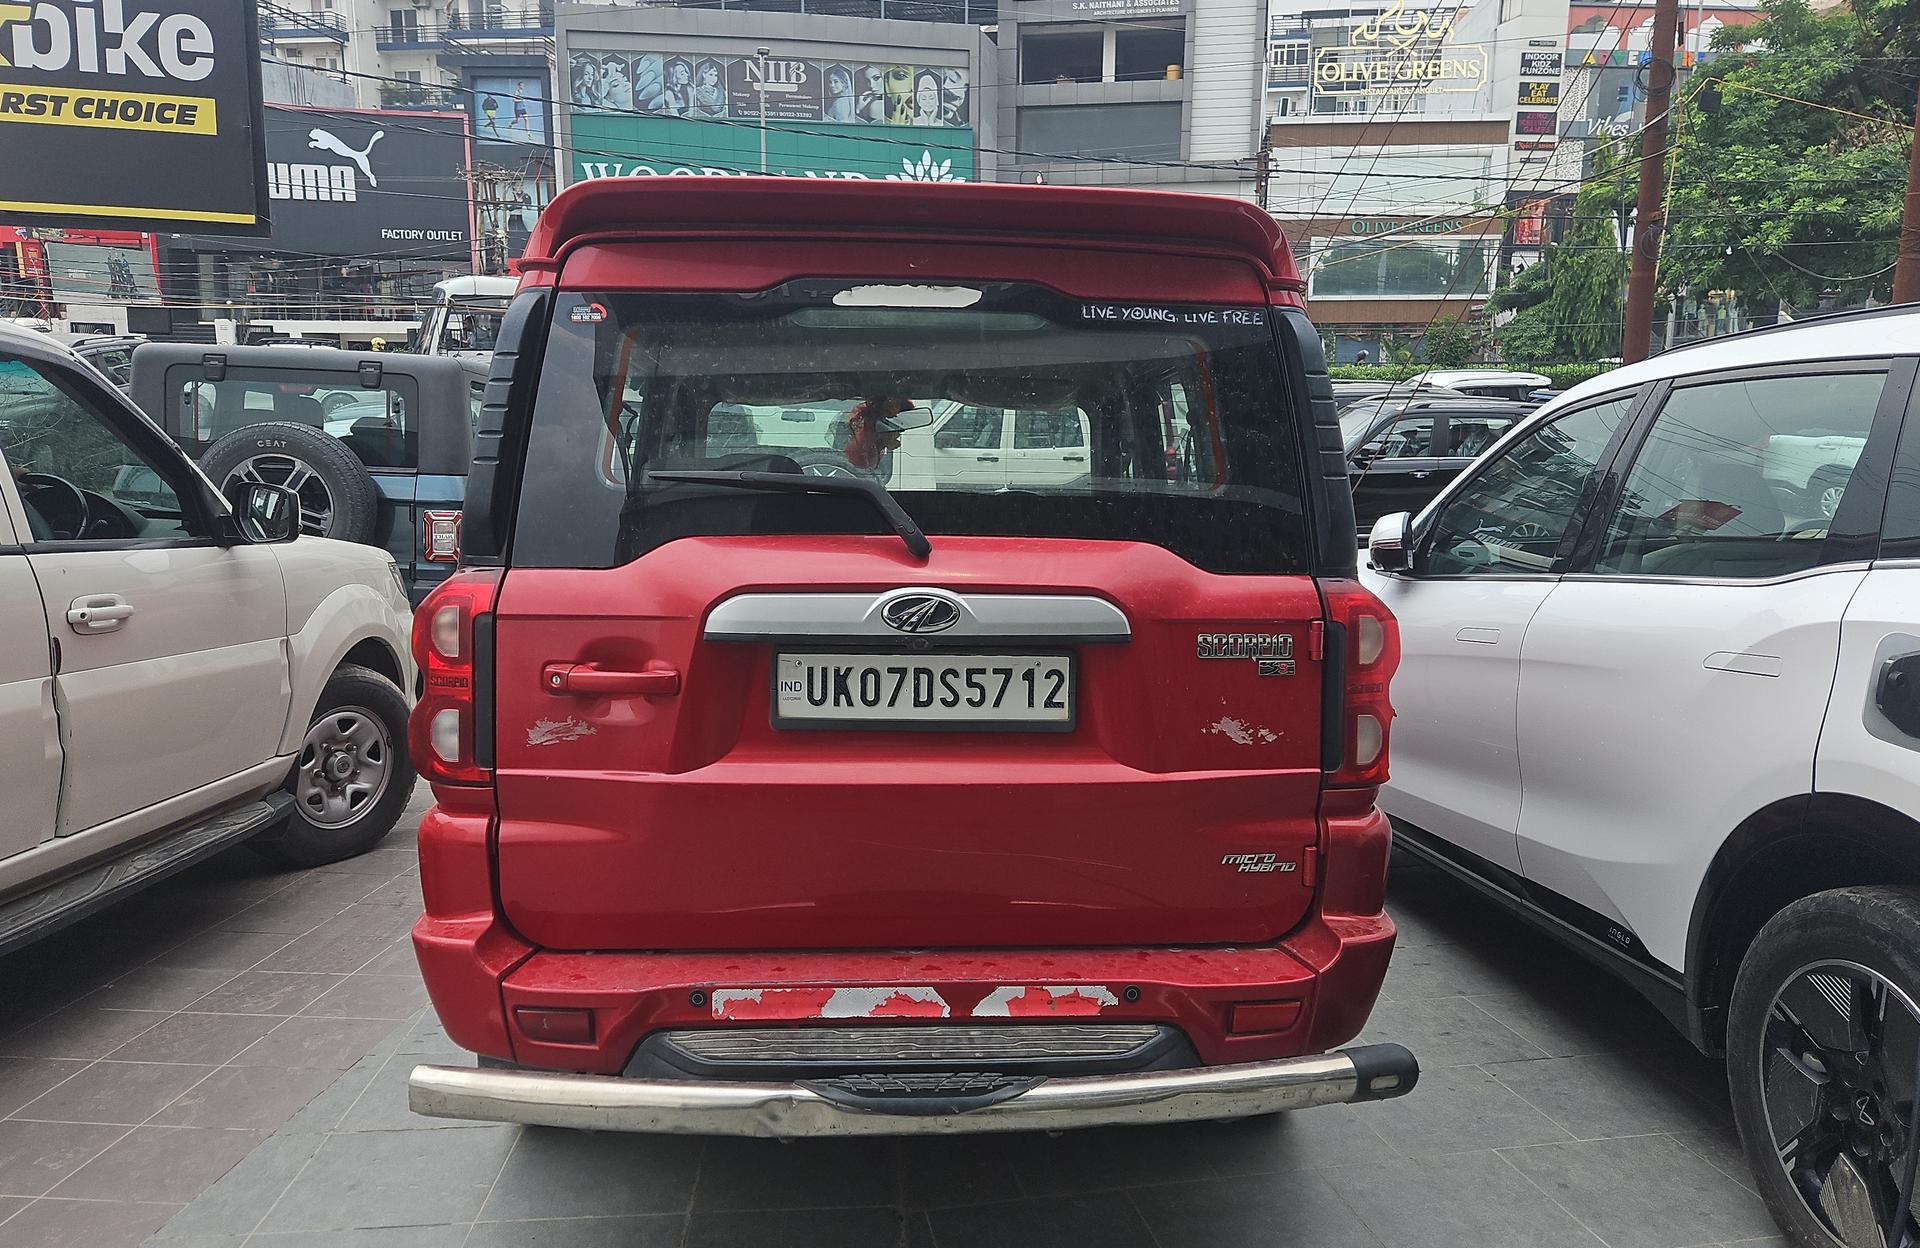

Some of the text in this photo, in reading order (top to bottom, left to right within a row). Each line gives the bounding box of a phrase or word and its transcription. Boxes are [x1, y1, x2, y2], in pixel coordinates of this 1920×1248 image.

[1089, 1, 1124, 9] NAITHANI
[0, 0, 214, 81] bike
[1321, 59, 1480, 82] OLIVE GREENS
[1521, 67, 1560, 75] FUNZONE
[0, 92, 198, 125] RST CHOICE
[1587, 115, 1629, 136] Vibes
[267, 163, 357, 201] UMA
[381, 229, 463, 240] FACTORY OUTLET
[1352, 220, 1398, 234] OLIVE
[1082, 305, 1117, 319] LIVE
[1184, 311, 1218, 323] LIVE
[1223, 310, 1263, 325] FREE
[257, 440, 287, 448] CEAT
[1197, 633, 1293, 659] SCORPIO
[780, 666, 1066, 709] IND UK07DS5712
